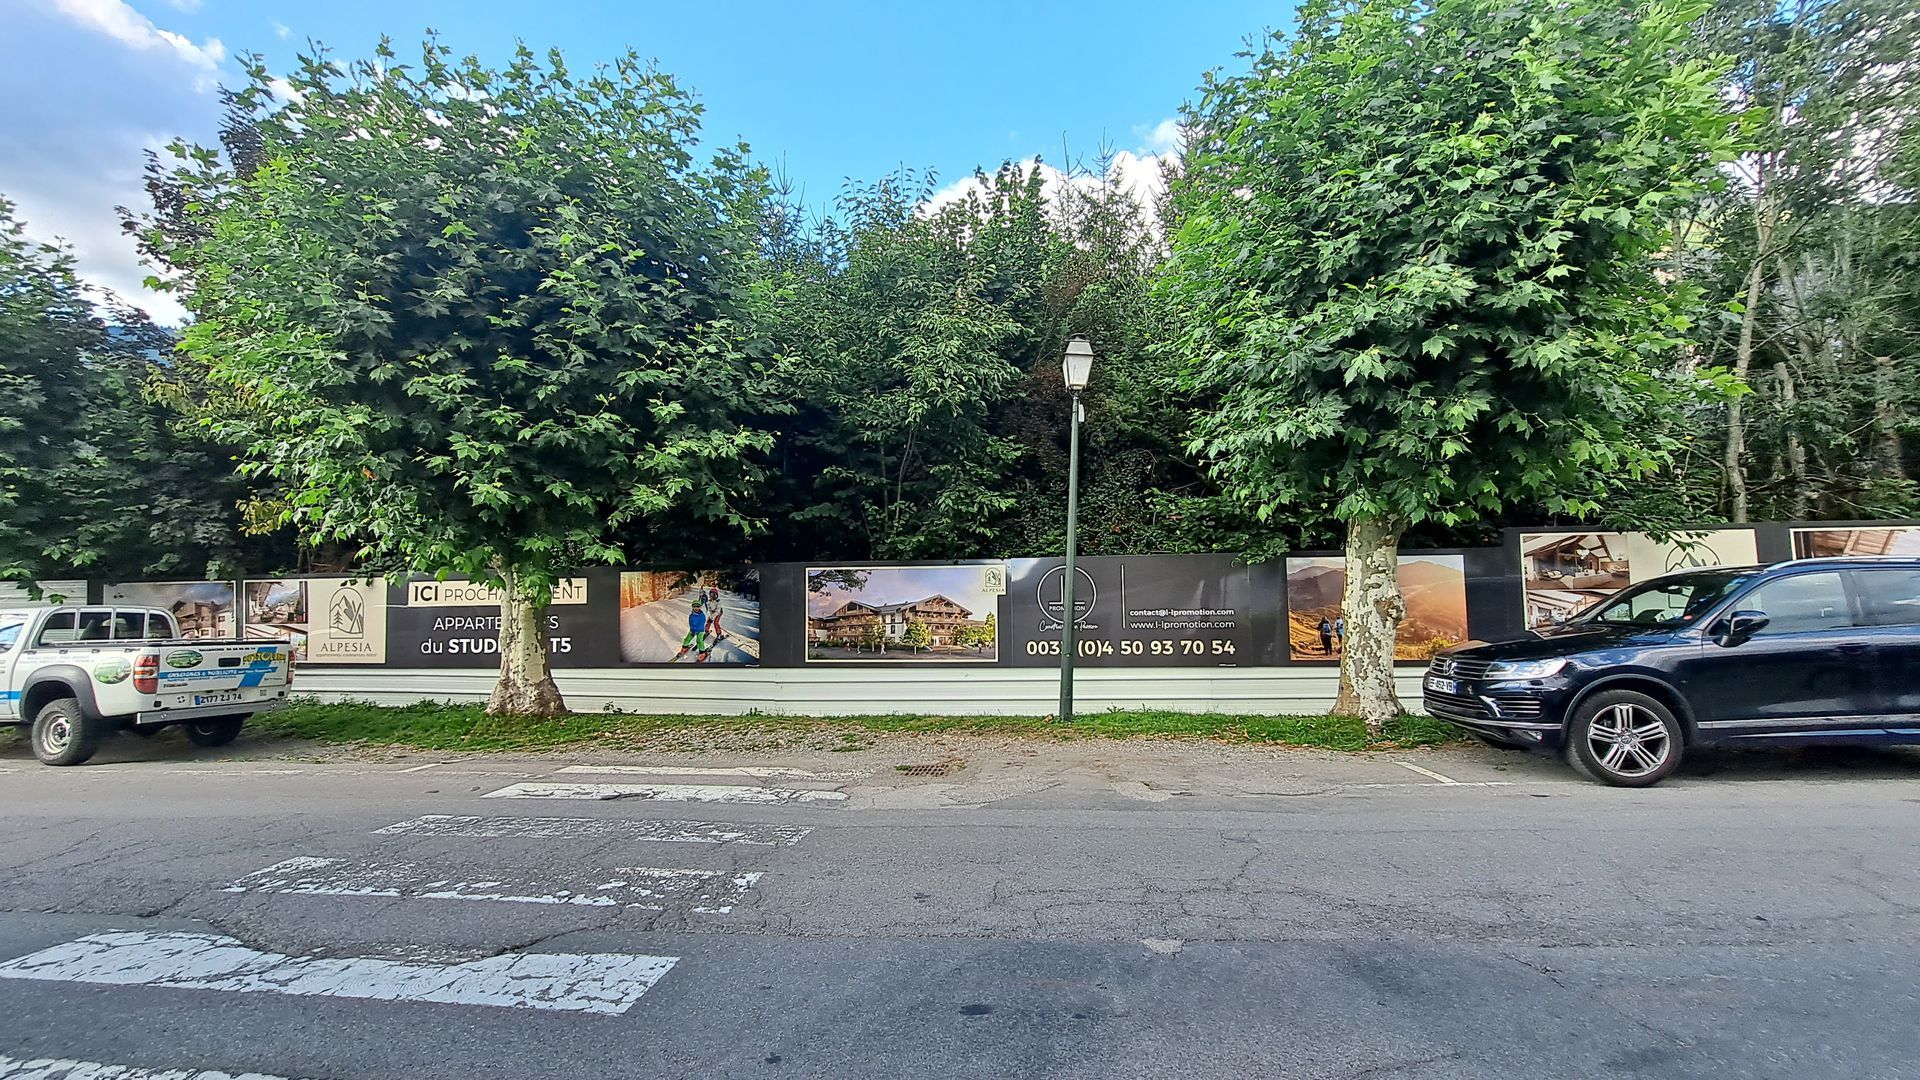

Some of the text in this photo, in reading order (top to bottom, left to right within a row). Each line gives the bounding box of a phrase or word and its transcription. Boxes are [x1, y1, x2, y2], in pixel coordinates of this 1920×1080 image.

[414, 585, 583, 602] ICI PROCHENT
[433, 615, 559, 631] APPARTES
[320, 642, 372, 652] ALPESIA
[421, 637, 572, 654] du STUDI T5
[1026, 639, 1236, 657] 003 (0)4 50 93 70 54
[200, 695, 218, 704] 2177
